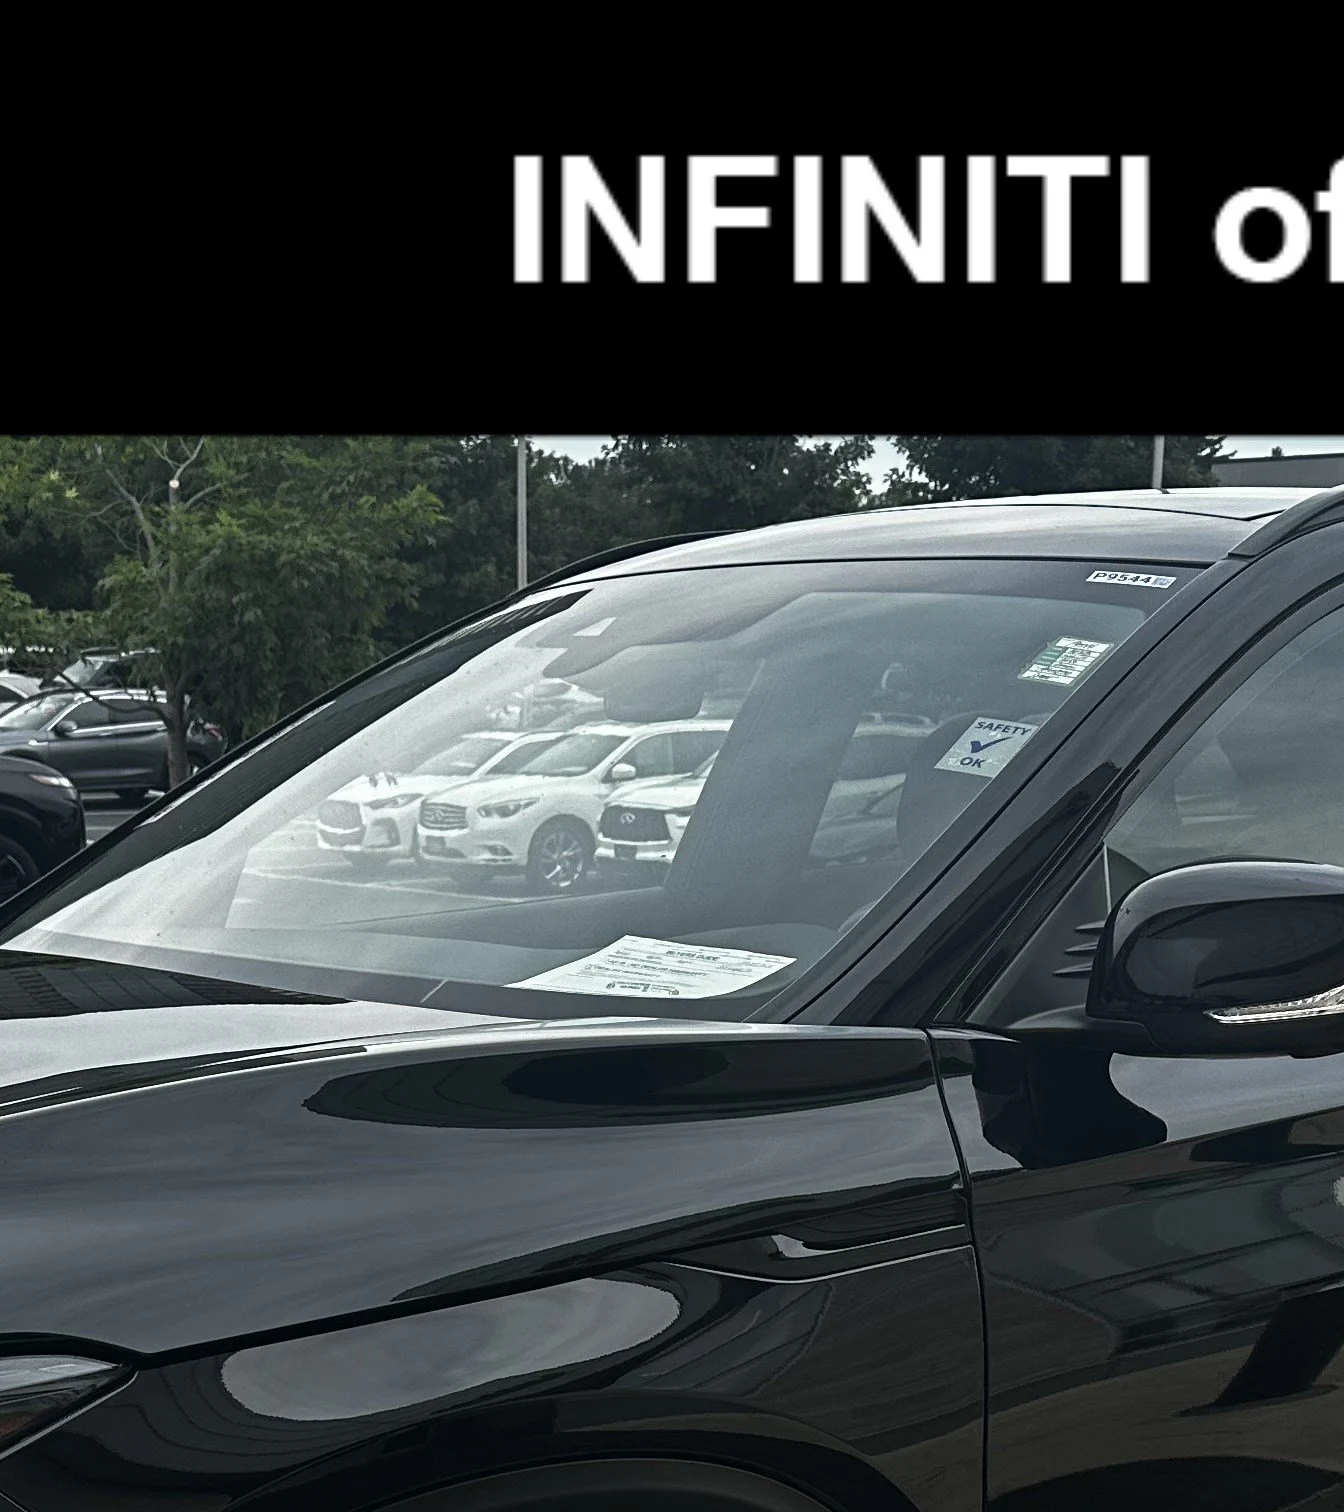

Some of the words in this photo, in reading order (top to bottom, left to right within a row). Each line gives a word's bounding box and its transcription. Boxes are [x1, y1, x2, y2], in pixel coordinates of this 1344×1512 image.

[1093, 571, 1153, 584] P9544
[974, 720, 1033, 736] SAFETY
[959, 756, 987, 769] OK
